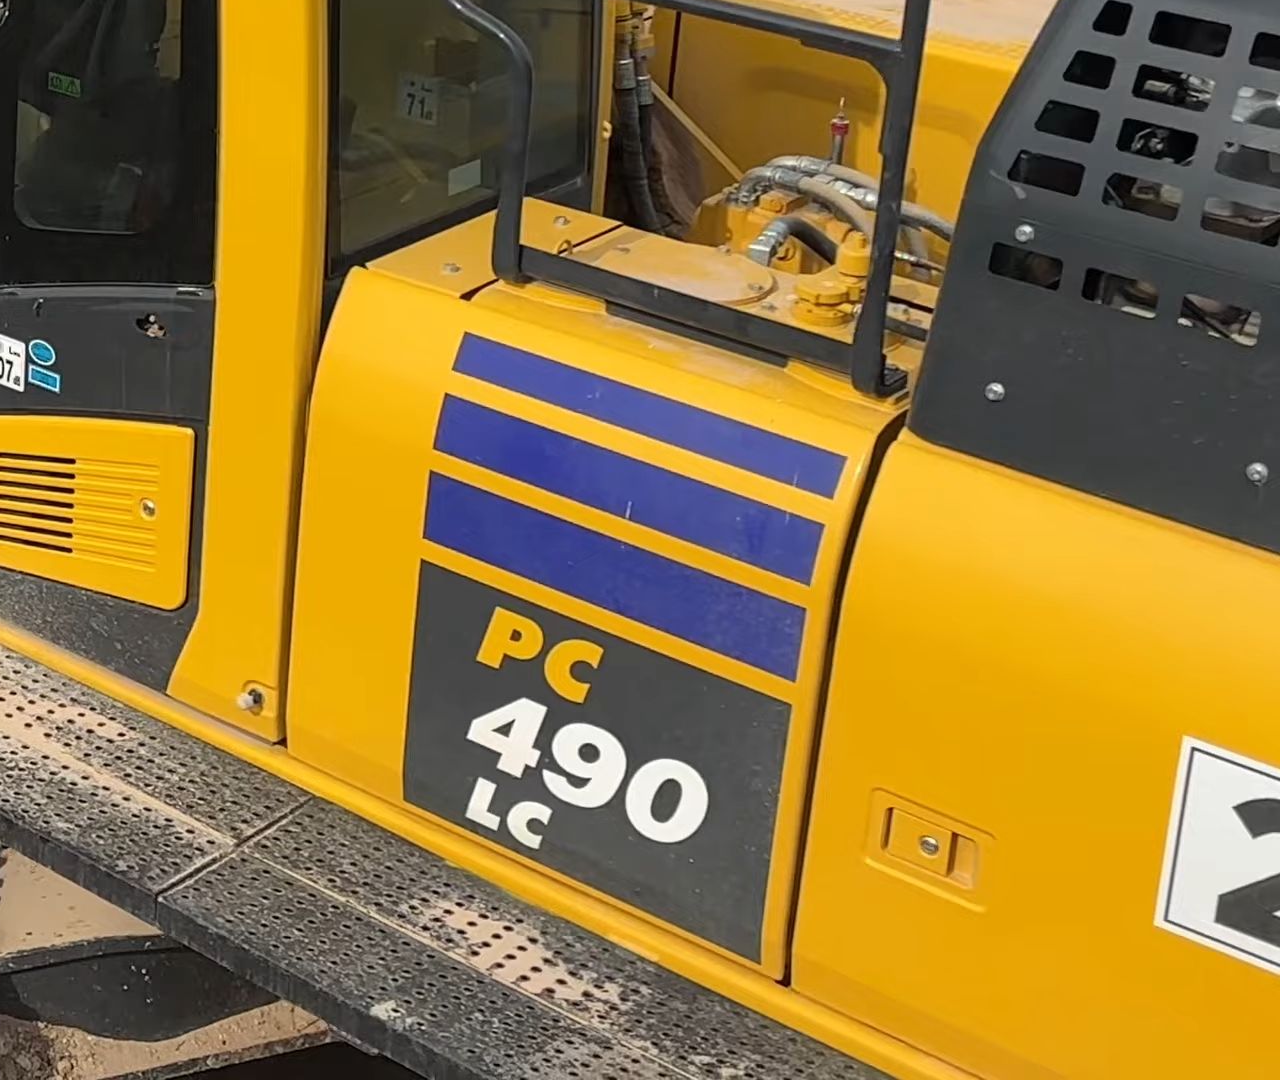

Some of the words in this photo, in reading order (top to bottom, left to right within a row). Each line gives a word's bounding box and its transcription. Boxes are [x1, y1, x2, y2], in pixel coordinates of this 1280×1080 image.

[476, 606, 604, 704] PC
[465, 776, 553, 850] LC
[466, 697, 709, 844] 490
